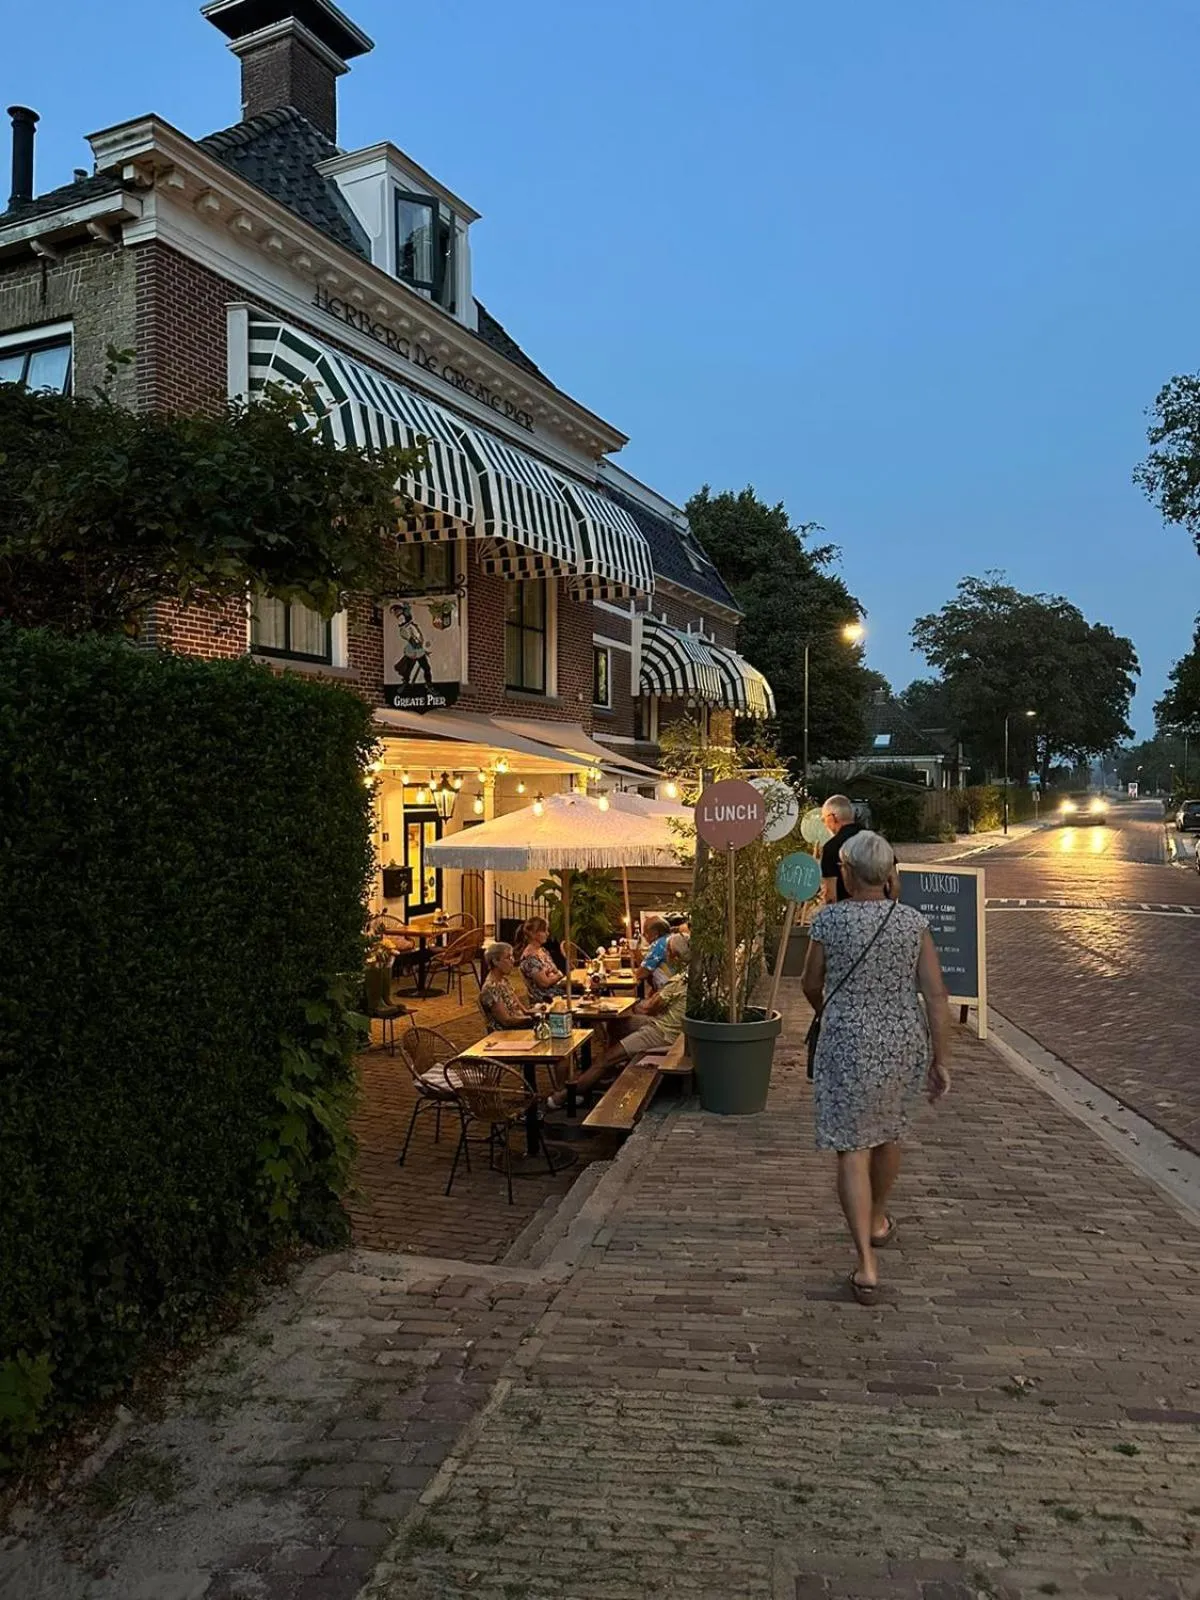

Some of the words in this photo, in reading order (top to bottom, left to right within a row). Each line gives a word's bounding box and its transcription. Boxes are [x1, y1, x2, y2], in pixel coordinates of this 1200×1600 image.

[313, 283, 410, 359] HERBERG
[413, 343, 440, 369] DE
[704, 803, 758, 822] LUNCH
